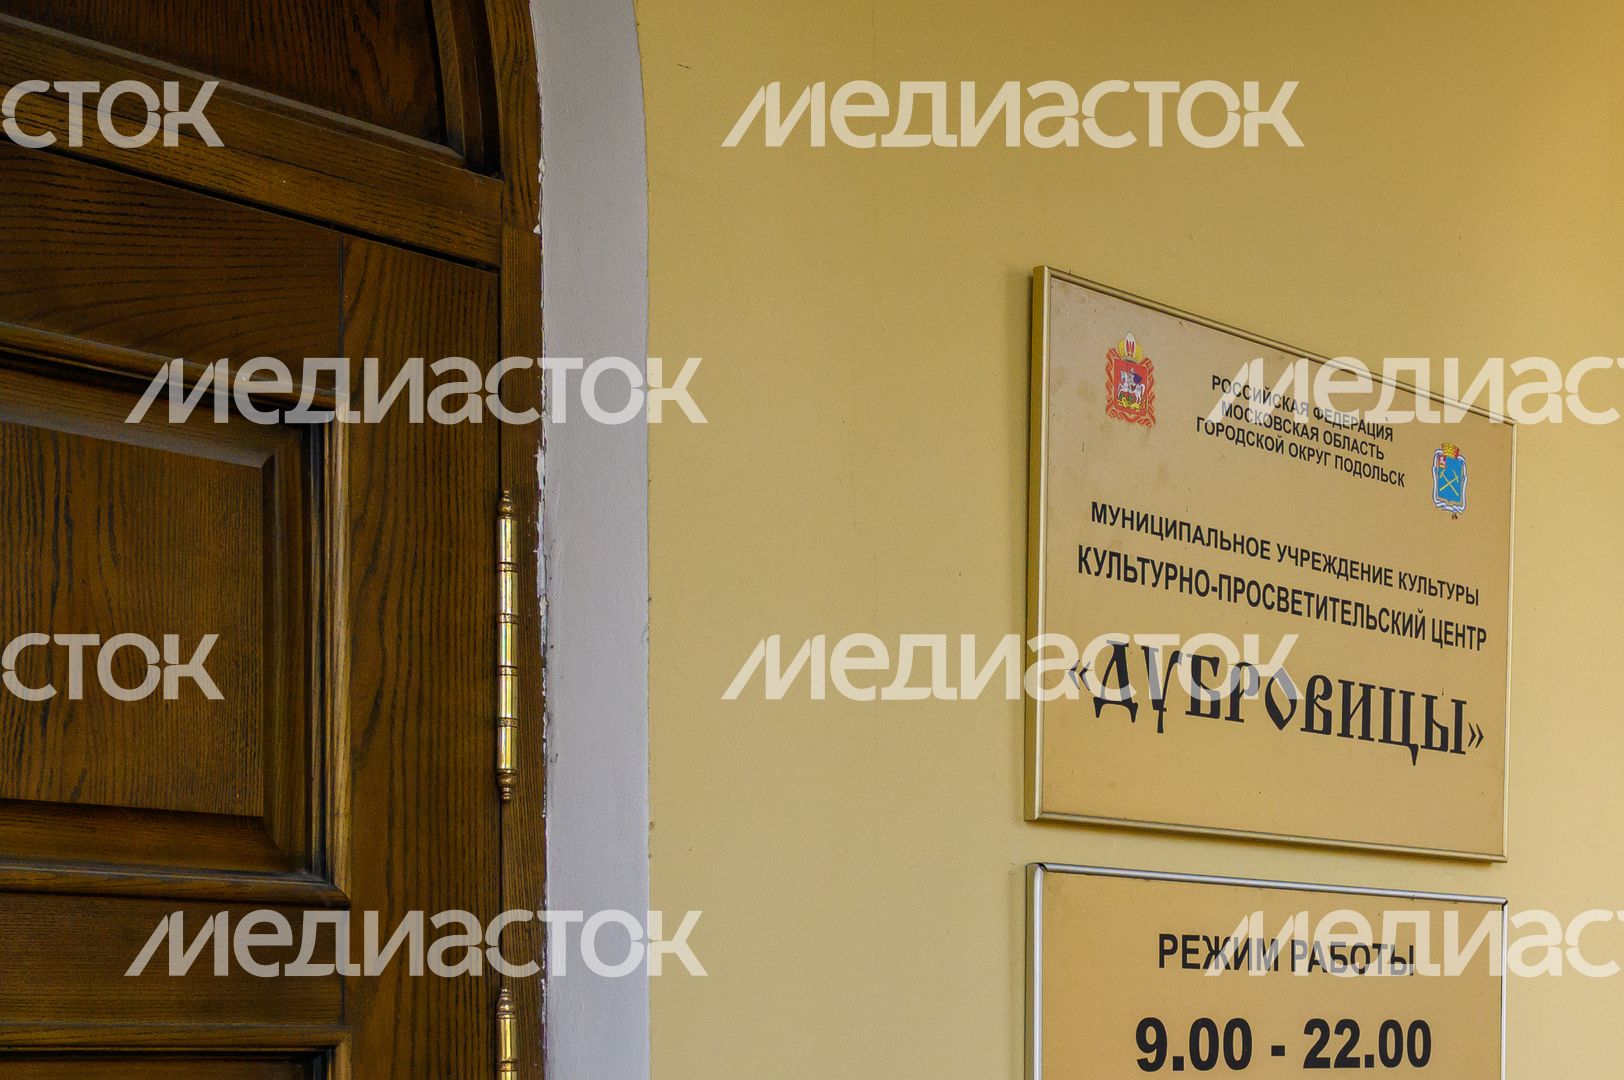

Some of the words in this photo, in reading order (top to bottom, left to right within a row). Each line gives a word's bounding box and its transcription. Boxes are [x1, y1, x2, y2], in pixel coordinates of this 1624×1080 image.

[1211, 374, 1310, 418] РОССИЙСКАЯ
[1313, 406, 1394, 442] ФЕДЕРАЦИЯ
[1221, 400, 1320, 442] МОСКОВСКАЯ
[1323, 430, 1385, 460] ОБЛАСТЬ
[1196, 416, 1284, 455] ГОРОДСКОЙ
[1288, 442, 1332, 467] ОКРУГ
[1334, 455, 1406, 488] ПОДОЛЬСК
[1091, 501, 1271, 560] МУНИЦИПАЛЬНОЕ
[1276, 542, 1393, 588] УЧРЕЖДЕНИЕ
[1398, 571, 1479, 606] КУЛЬТУРЫ
[1078, 544, 1426, 641] КУЛЬТУРНО-ПРОСВЕТИТЕЛЬСКИЙ
[1431, 618, 1487, 651] ЦЕНТР
[1158, 933, 1280, 973] РЕЖИМ
[1290, 939, 1415, 976] РАБОТЫ
[1135, 1016, 1253, 1073] 9.00
[1303, 1018, 1432, 1070] 22.00
